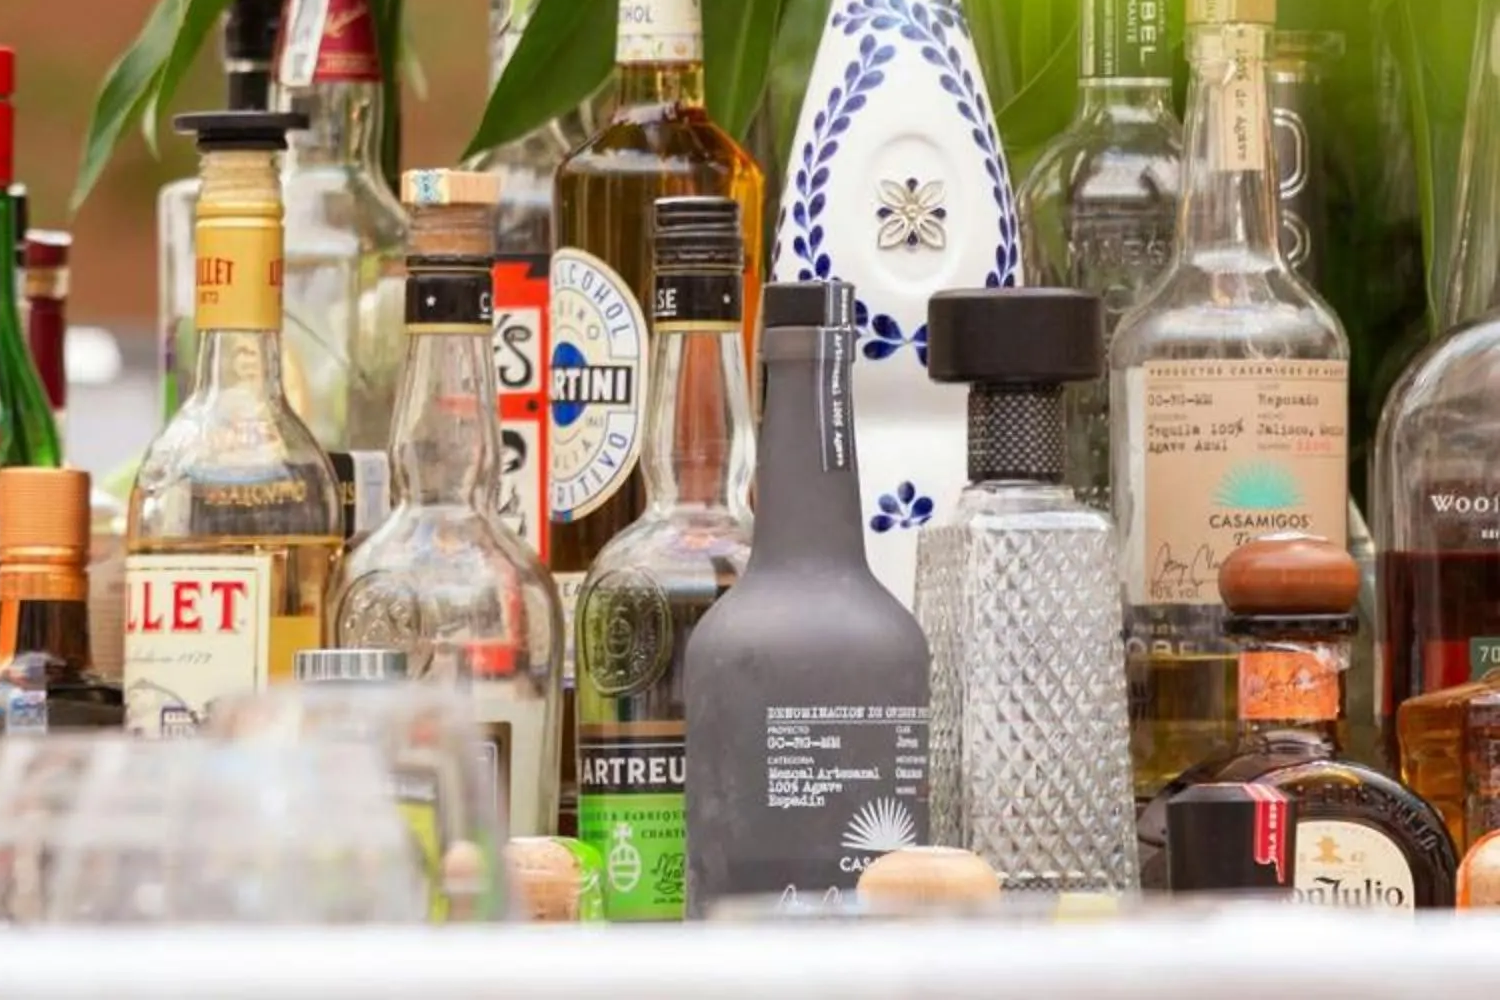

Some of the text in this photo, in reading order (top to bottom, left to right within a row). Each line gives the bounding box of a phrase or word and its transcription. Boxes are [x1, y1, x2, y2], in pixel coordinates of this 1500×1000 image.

[1148, 423, 1200, 438] Tequila
[1209, 513, 1310, 529] CASAMIGOS
[802, 781, 844, 796] Agave
